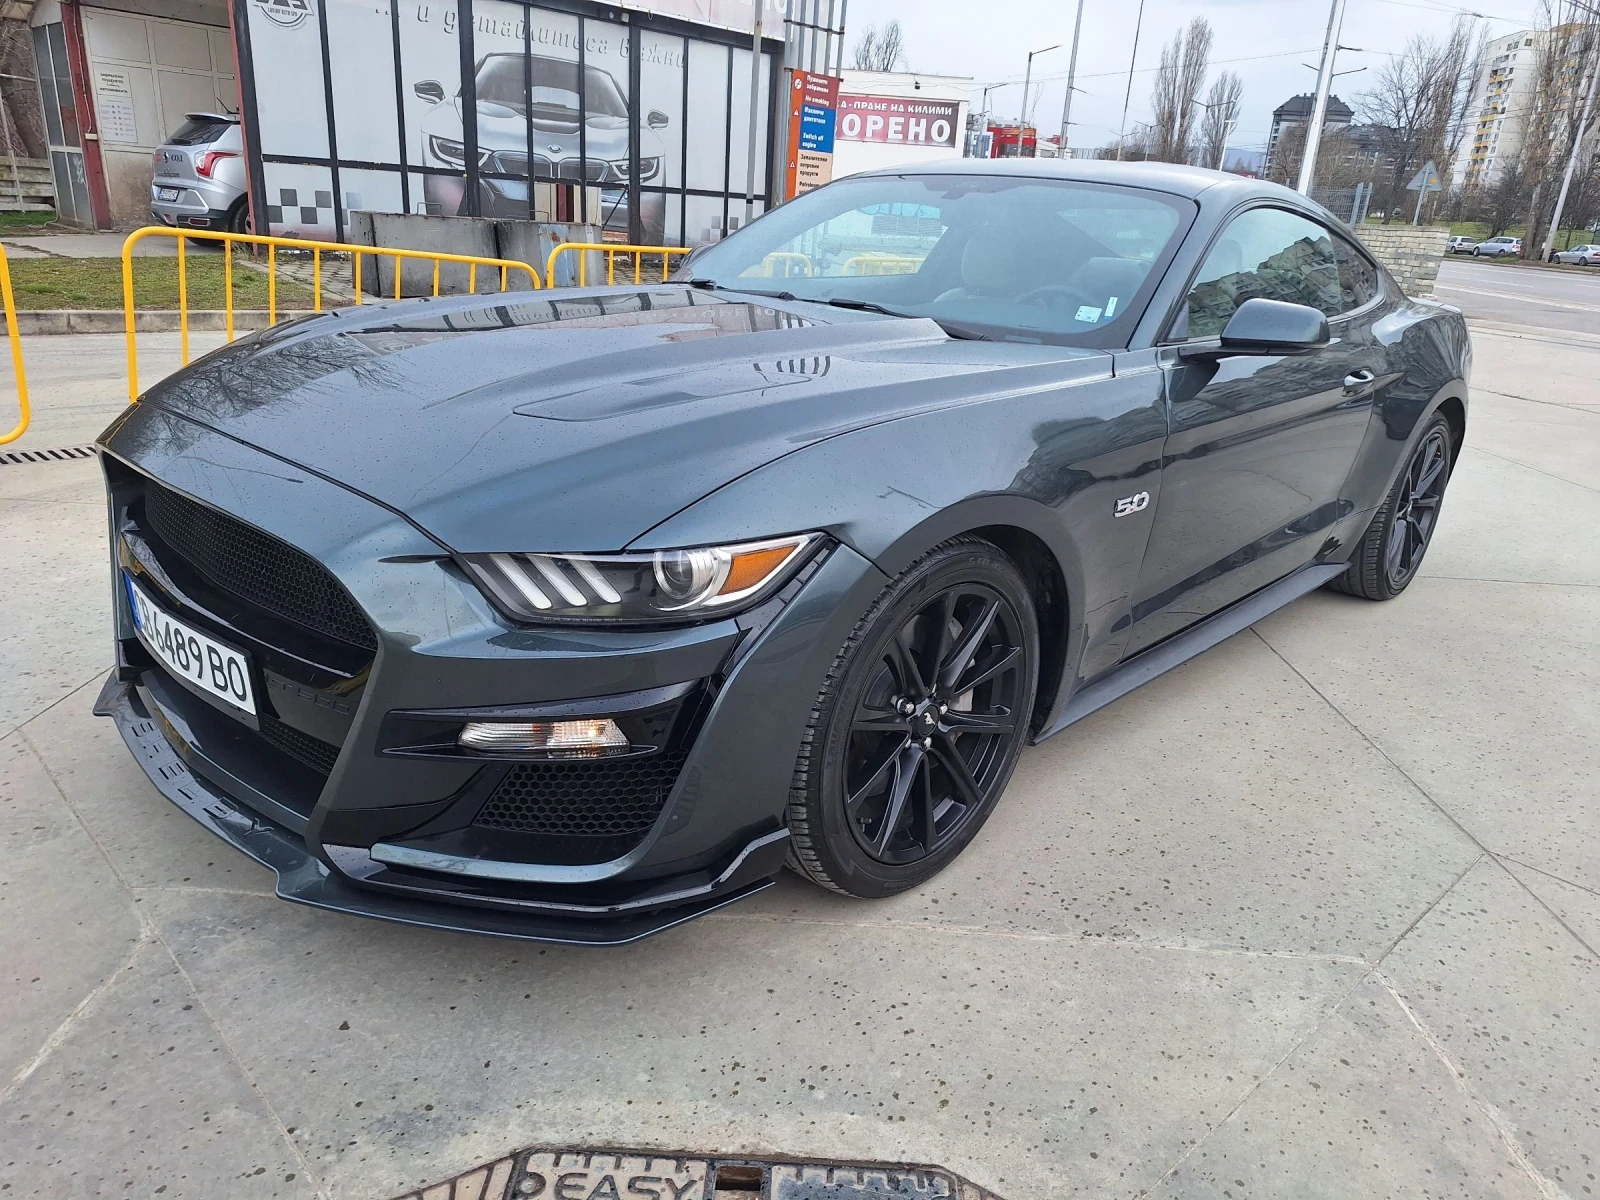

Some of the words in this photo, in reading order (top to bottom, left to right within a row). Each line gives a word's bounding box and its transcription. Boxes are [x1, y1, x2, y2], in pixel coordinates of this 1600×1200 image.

[805, 94, 812, 102] No
[812, 98, 830, 107] smoking
[853, 101, 888, 112] ПРАНЕ
[890, 103, 905, 112] НА
[907, 104, 953, 116] КИЛИМИ
[836, 113, 951, 143] ОРЕНО
[802, 132, 817, 141] Switch
[802, 141, 817, 149] engine
[1113, 491, 1150, 518] 5.0
[153, 610, 204, 680] 6489
[206, 644, 248, 702] BO
